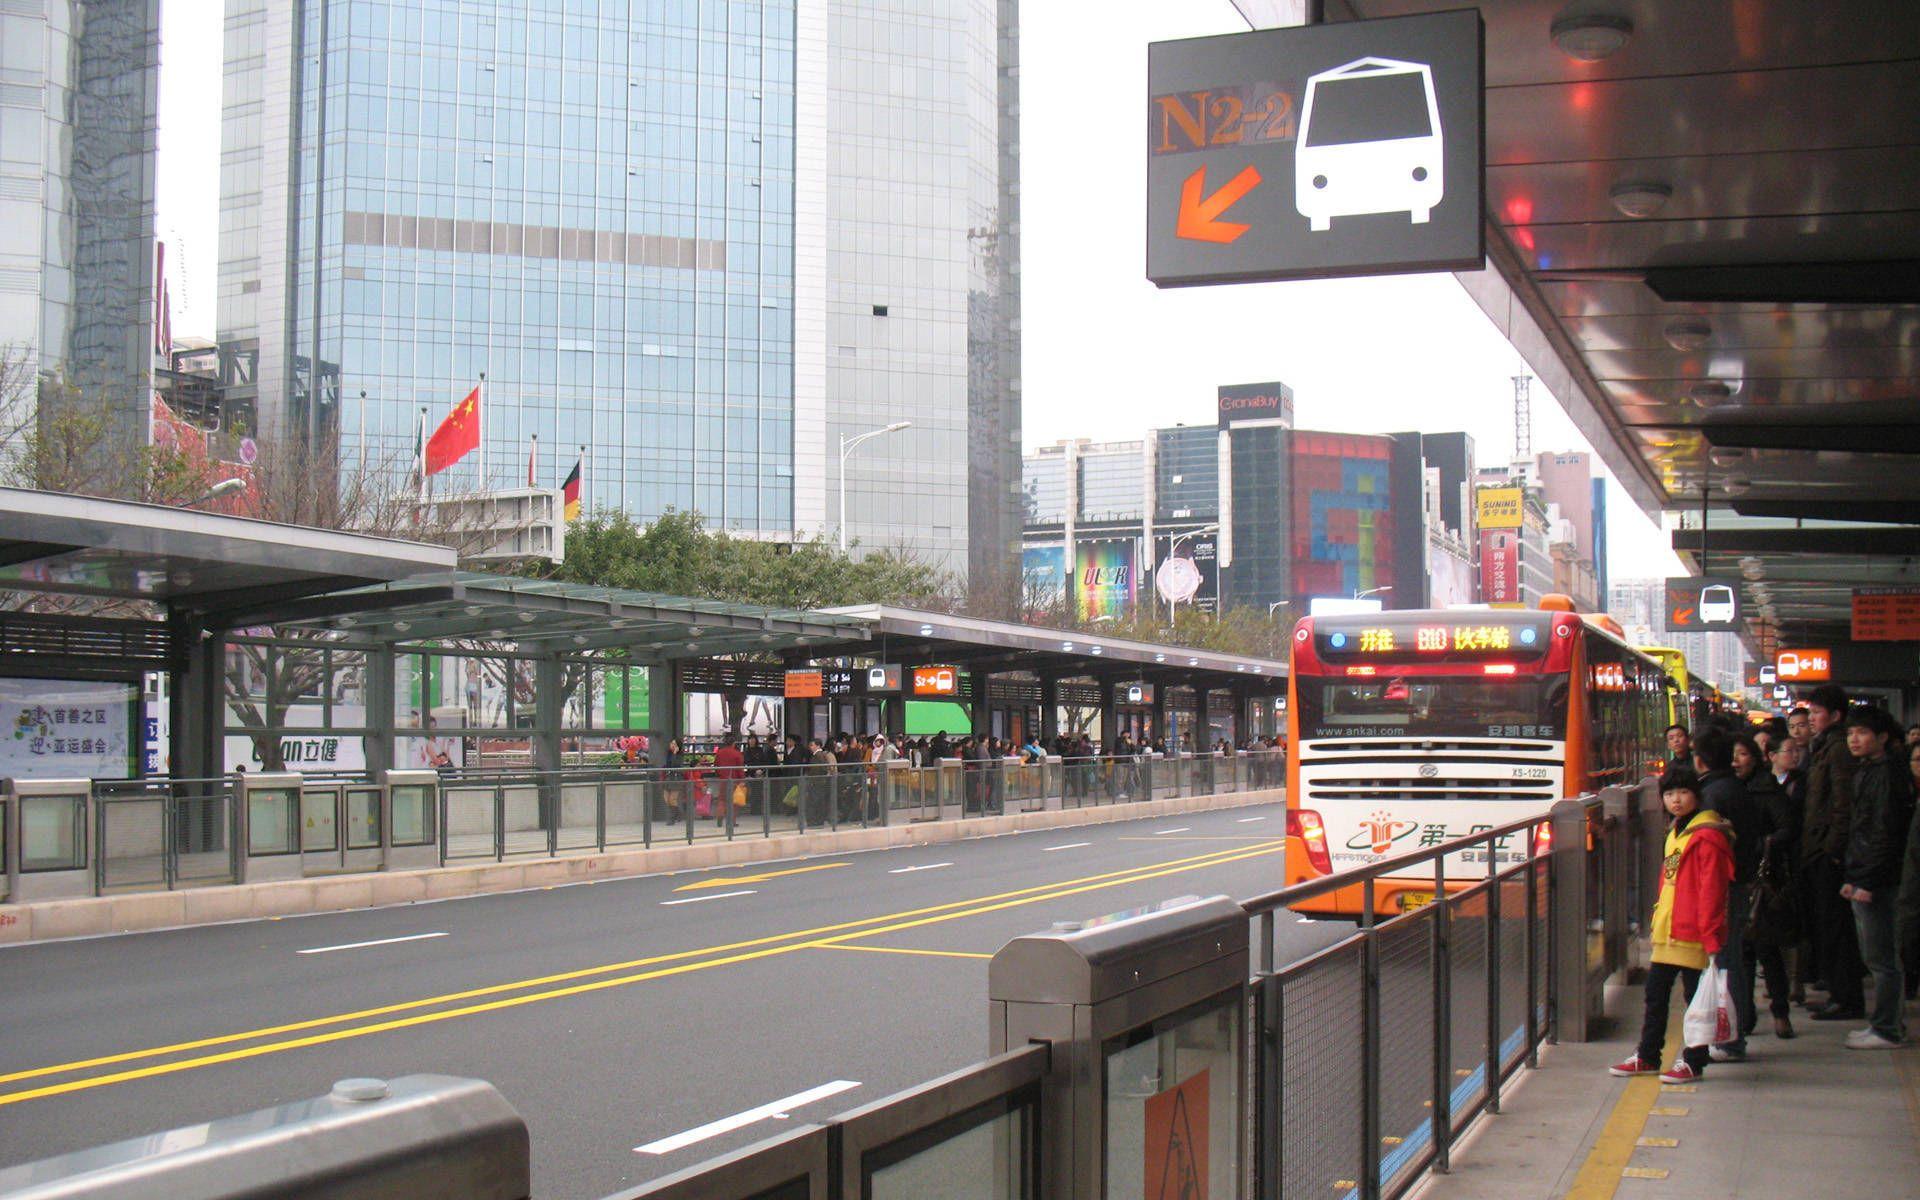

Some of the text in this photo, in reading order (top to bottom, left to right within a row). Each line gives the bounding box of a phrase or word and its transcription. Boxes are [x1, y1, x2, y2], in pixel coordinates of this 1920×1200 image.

[1153, 92, 1294, 155] N2-2
[1812, 657, 1828, 671] N3
[915, 676, 927, 687] S2
